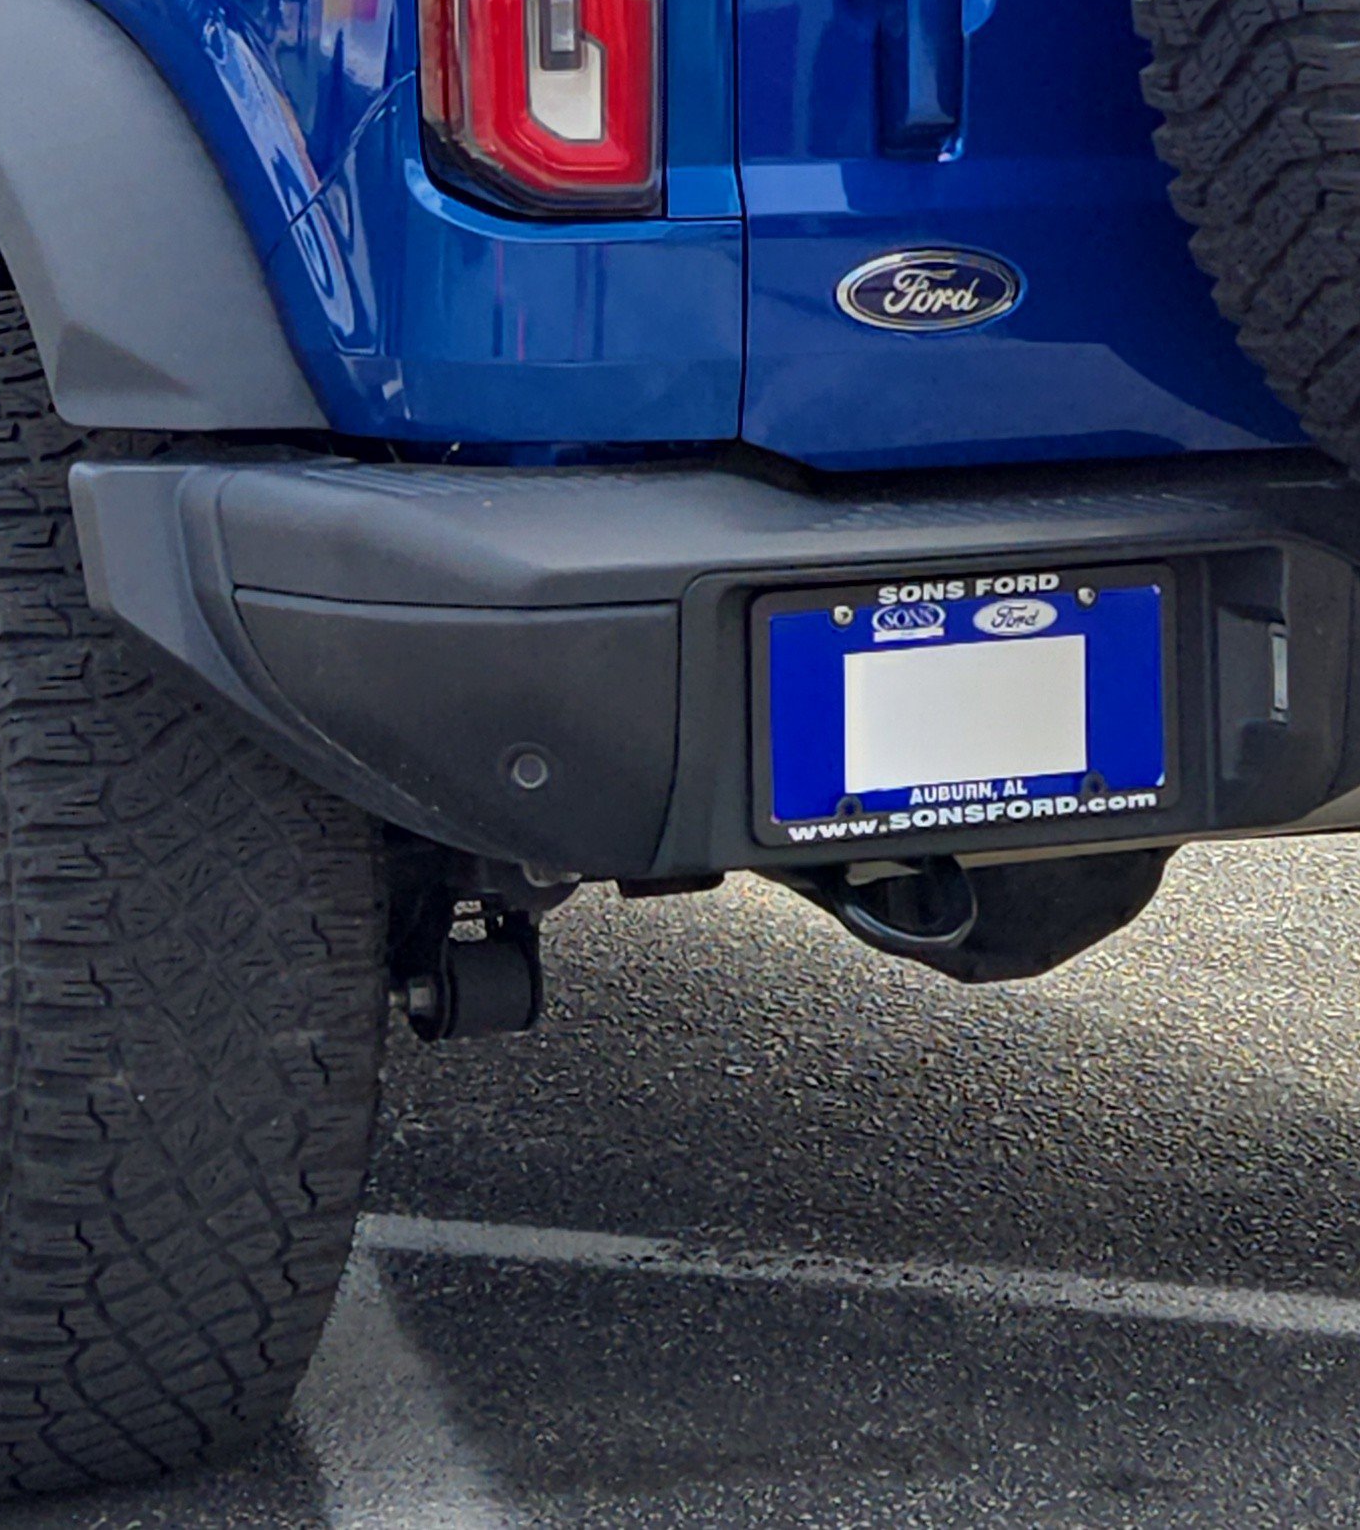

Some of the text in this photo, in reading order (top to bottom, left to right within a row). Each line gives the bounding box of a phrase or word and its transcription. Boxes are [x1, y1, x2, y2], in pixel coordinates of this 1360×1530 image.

[883, 268, 981, 315] Ford
[877, 573, 1060, 605] SONS FORD
[990, 603, 1042, 629] Ford
[909, 779, 1028, 805] AUBURN, AL
[788, 791, 1158, 842] www.SONSFORD.com
